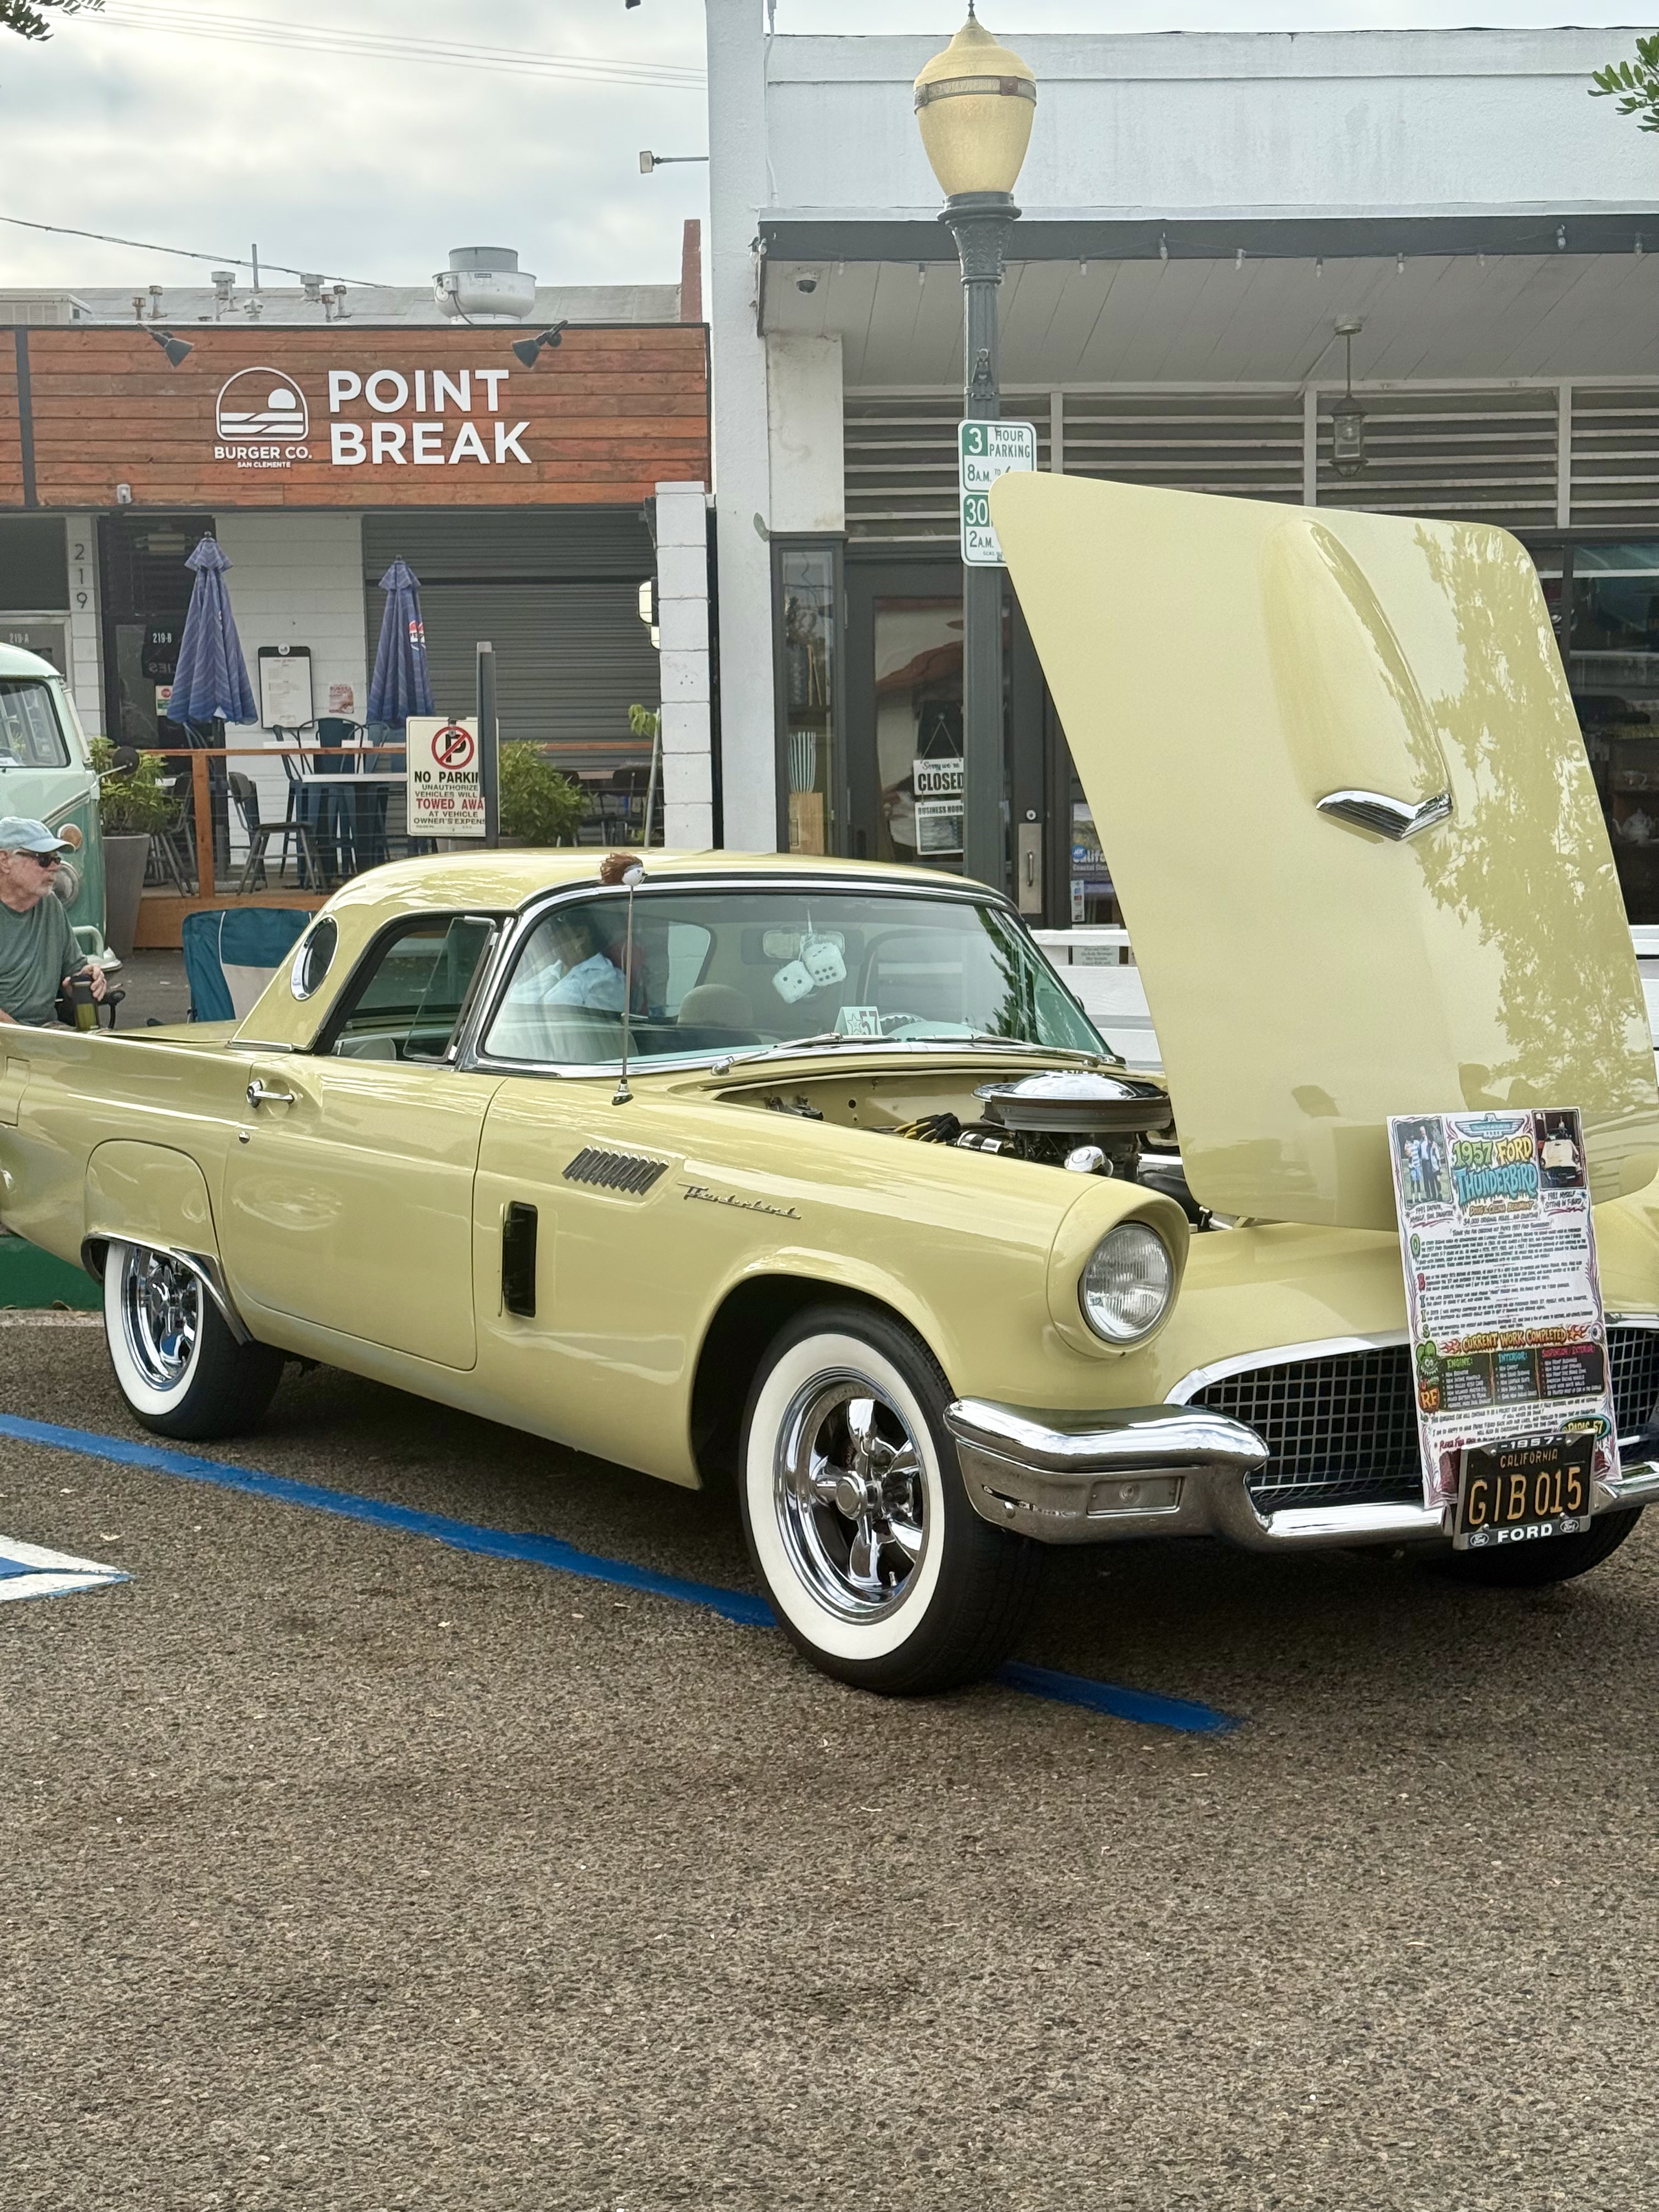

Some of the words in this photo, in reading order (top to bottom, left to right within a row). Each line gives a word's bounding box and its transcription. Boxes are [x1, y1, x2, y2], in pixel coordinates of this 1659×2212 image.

[329, 369, 509, 413] POINT
[331, 422, 532, 465] BREAK
[968, 427, 982, 454] 3
[996, 430, 1024, 442] HOUR
[214, 447, 280, 459] BURGER
[285, 447, 312, 459] CO.
[990, 444, 1030, 458] PARKING
[966, 498, 988, 525] 30
[153, 633, 172, 644] 219-B
[414, 771, 431, 783] NO
[439, 771, 478, 783] PARKI
[918, 772, 964, 791] CLOSED
[416, 798, 454, 810] TOWED
[461, 799, 484, 810] AWA
[918, 806, 946, 815] BUSINESS
[859, 1011, 878, 1035] 57
[1453, 1139, 1493, 1169] 1957
[1496, 1135, 1533, 1166] FORD
[1462, 1331, 1499, 1353] CURRENT
[1499, 1330, 1526, 1348] WORK
[1525, 1327, 1567, 1346] COMPLETED
[1447, 1357, 1473, 1369] ENGINE:
[1498, 1351, 1528, 1363] INTERIOR:
[1420, 1389, 1437, 1408] RF
[1500, 1448, 1558, 1469] CALIFORNIA
[1469, 1474, 1526, 1525] GIB
[1535, 1466, 1582, 1516] 015
[1497, 1523, 1553, 1543] FORD
